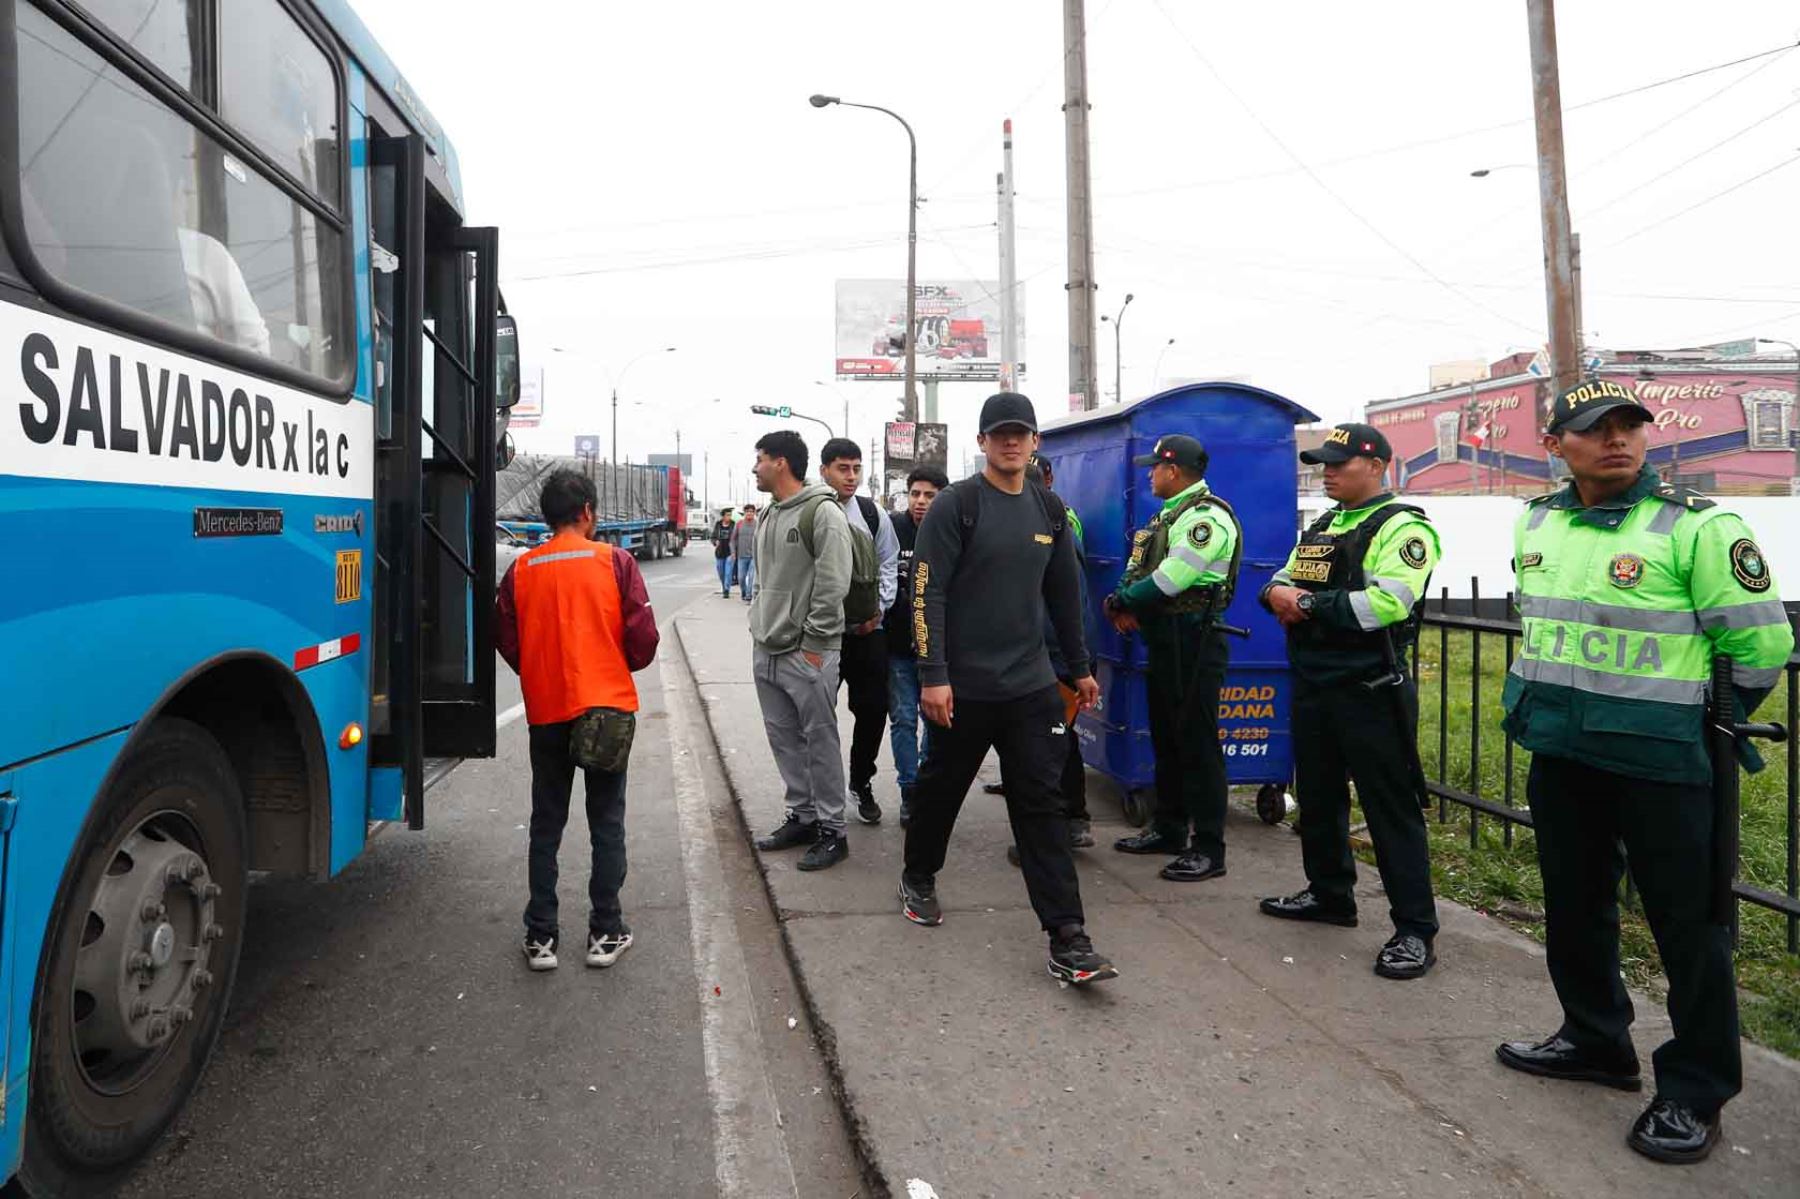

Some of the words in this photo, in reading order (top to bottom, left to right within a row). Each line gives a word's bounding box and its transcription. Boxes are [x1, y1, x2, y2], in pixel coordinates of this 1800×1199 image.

[19, 332, 276, 470] SALVADOR
[282, 421, 299, 472] x
[308, 409, 328, 476] la
[337, 433, 349, 478] c
[1565, 380, 1639, 410] POLICIA
[1633, 380, 1724, 406] Imperio
[198, 510, 281, 533] Mercedes-Benz
[336, 563, 360, 600] 8110
[1232, 727, 1269, 740] 4230
[1240, 744, 1268, 756] 501
